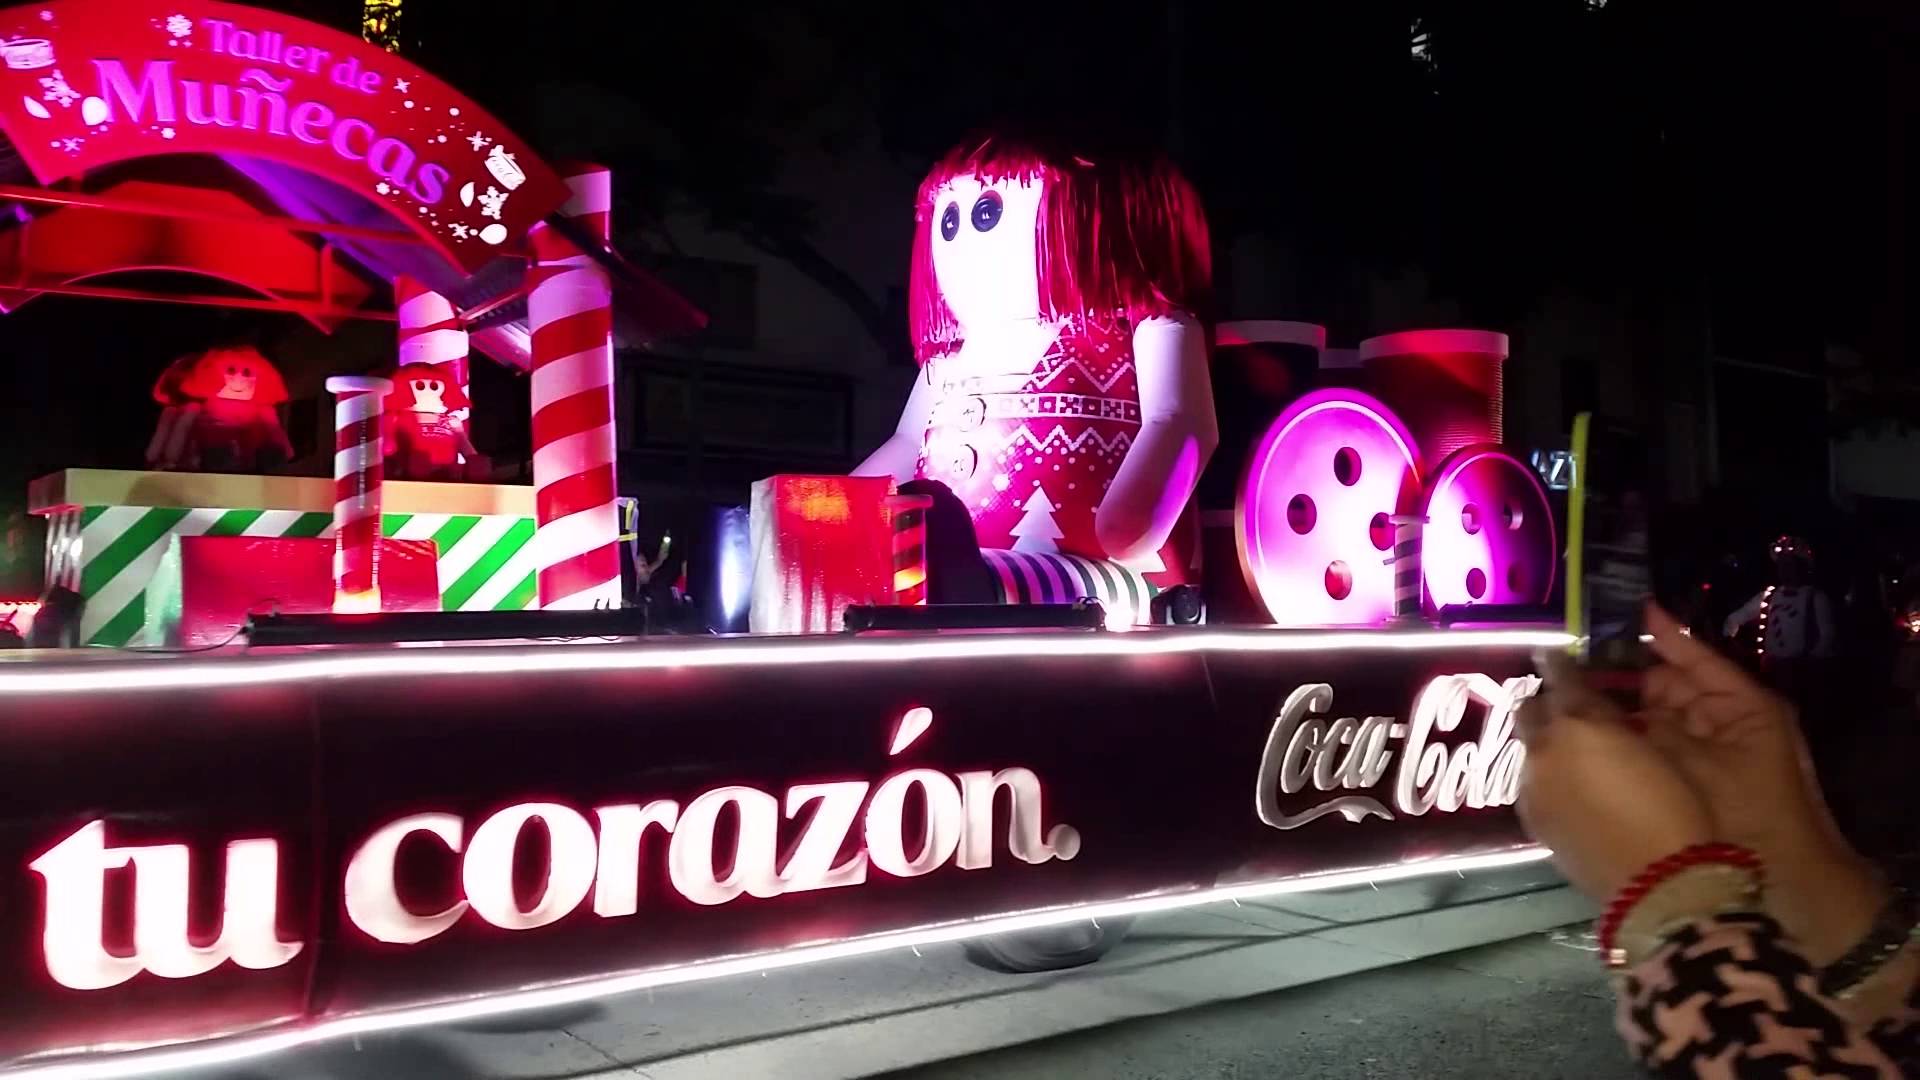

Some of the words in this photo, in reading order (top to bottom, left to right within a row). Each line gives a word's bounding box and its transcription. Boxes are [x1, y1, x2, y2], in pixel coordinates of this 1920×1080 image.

[91, 58, 450, 205] Muñecas
[204, 17, 331, 74] Taller
[330, 56, 383, 95] de
[1256, 672, 1543, 830] Coca-Cola
[29, 819, 304, 990] tu
[344, 706, 1081, 944] corazón.
